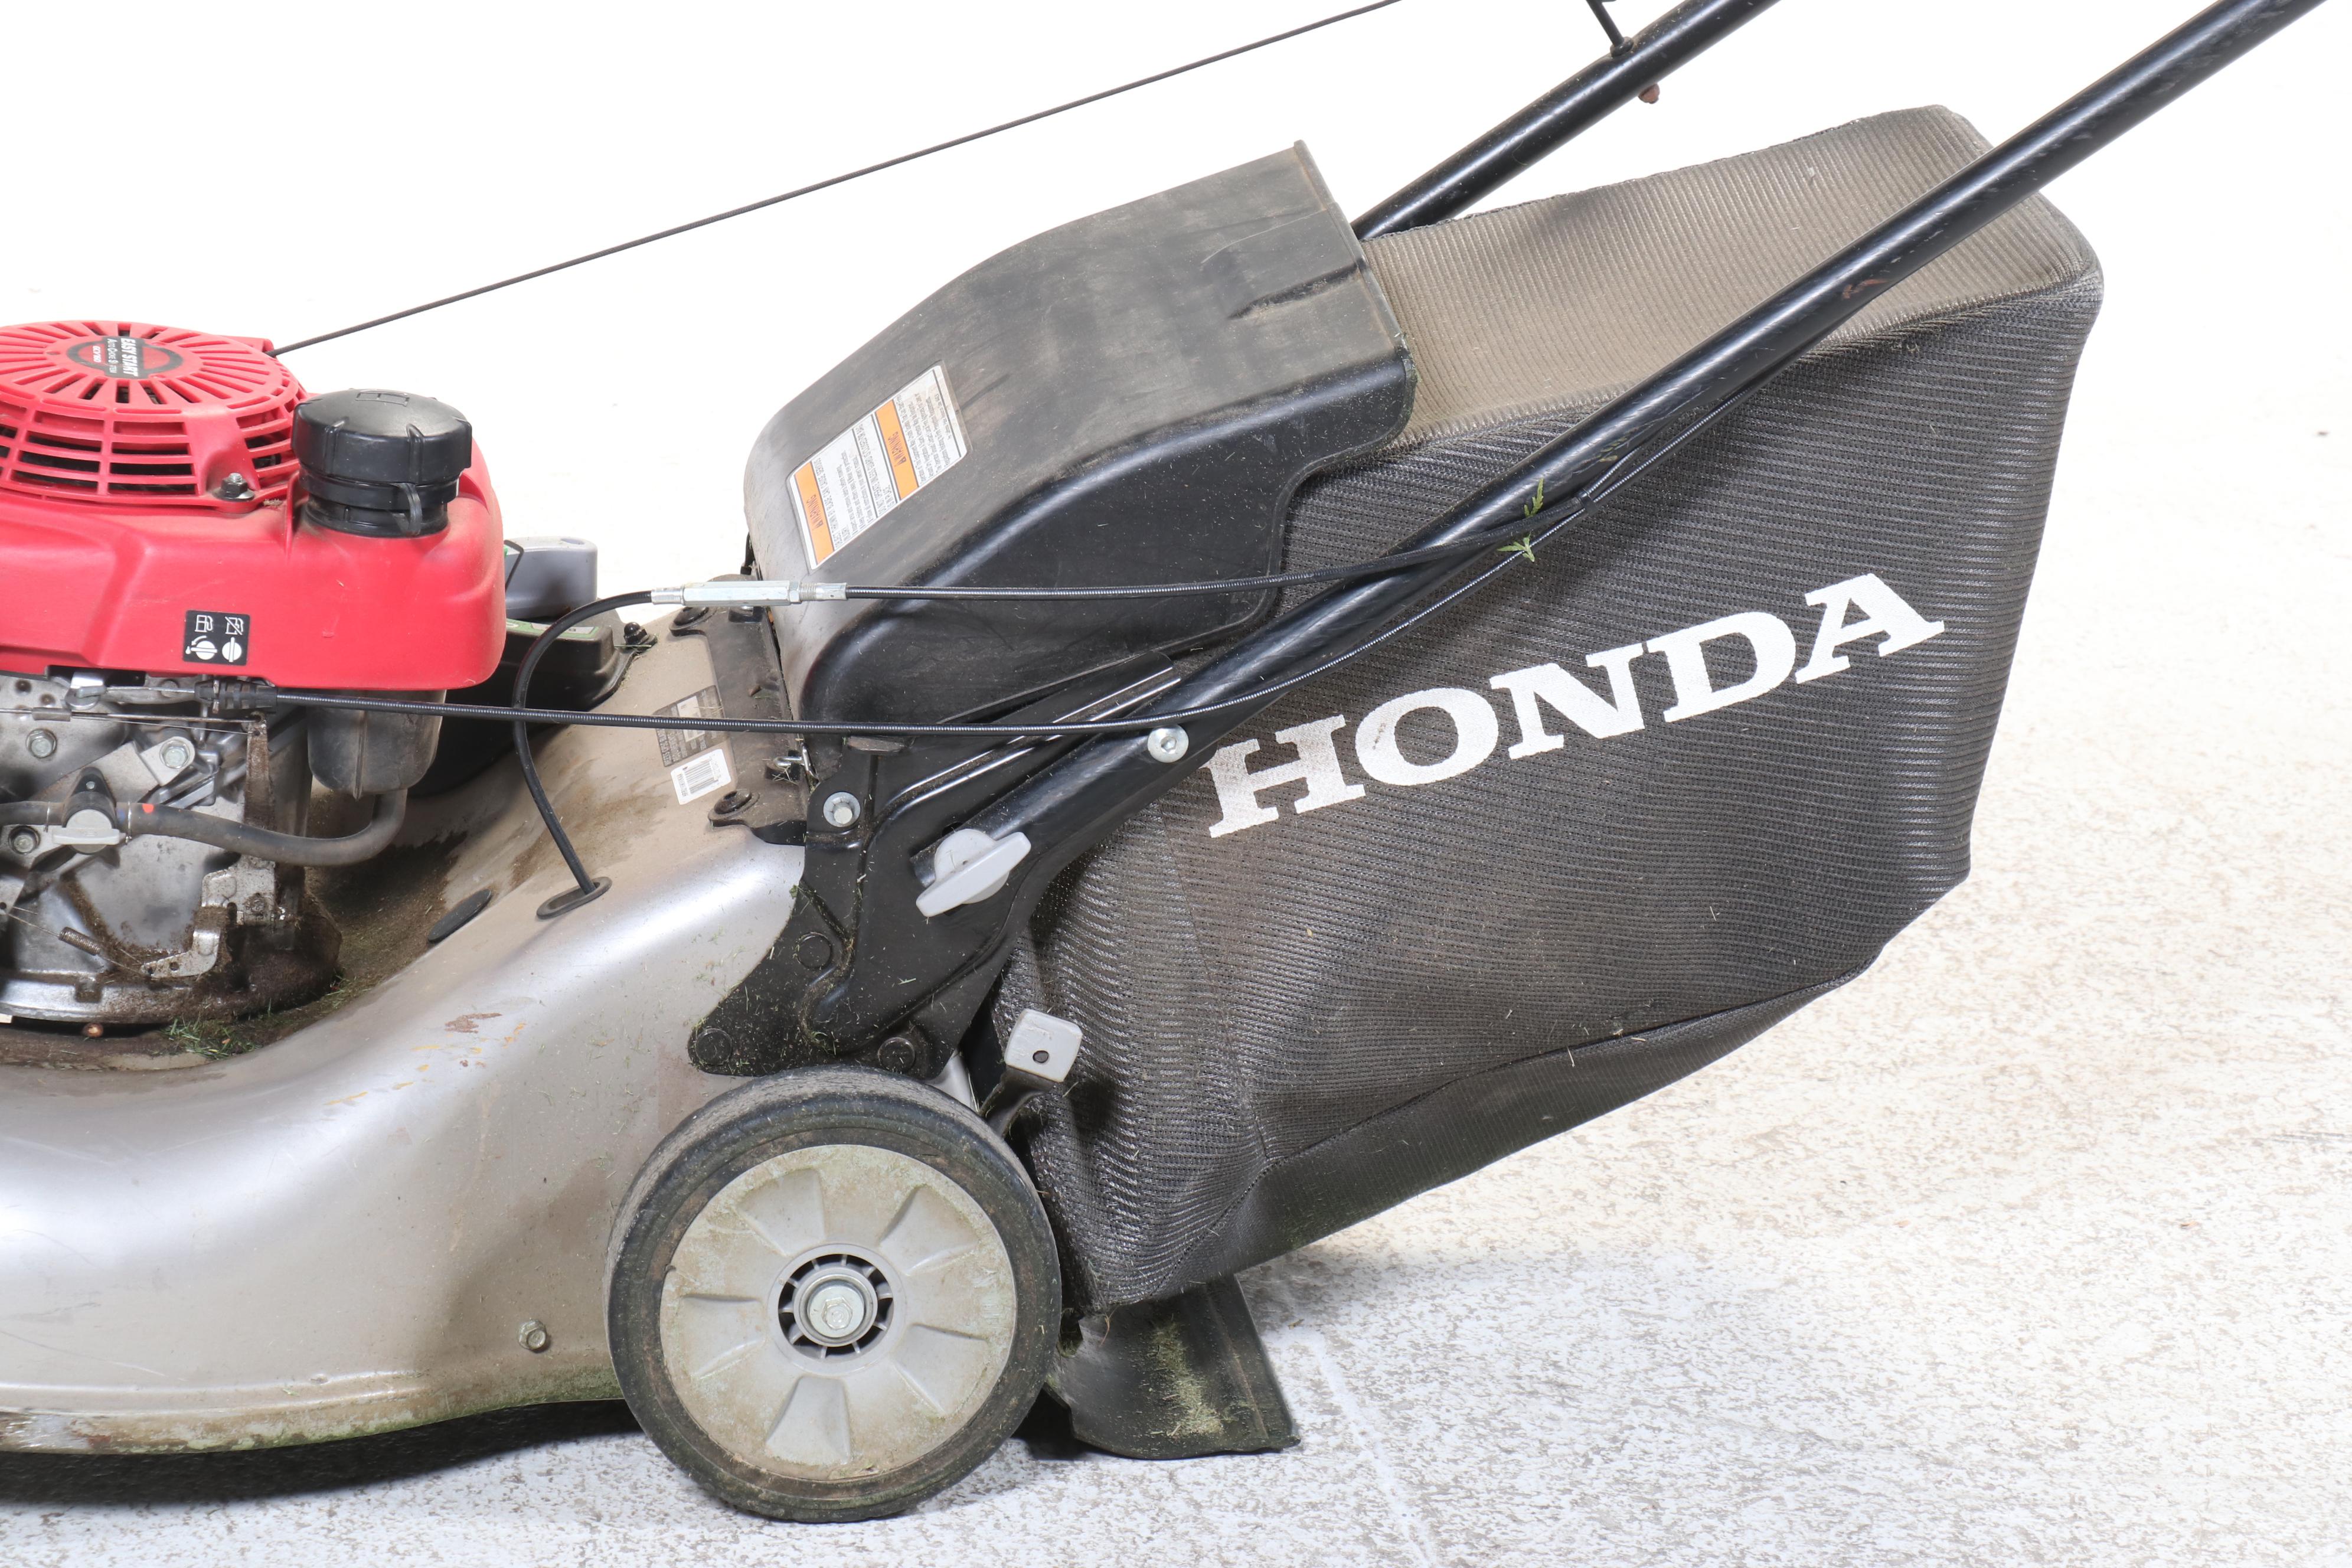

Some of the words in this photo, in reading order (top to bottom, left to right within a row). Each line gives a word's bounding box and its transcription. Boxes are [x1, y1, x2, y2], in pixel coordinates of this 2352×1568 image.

[92, 345, 102, 363] GCV160
[120, 338, 137, 355] EASY
[122, 354, 138, 377] START
[887, 430, 904, 462] WARNING
[805, 492, 822, 525] WARNING
[1206, 573, 1945, 838] HONDA
